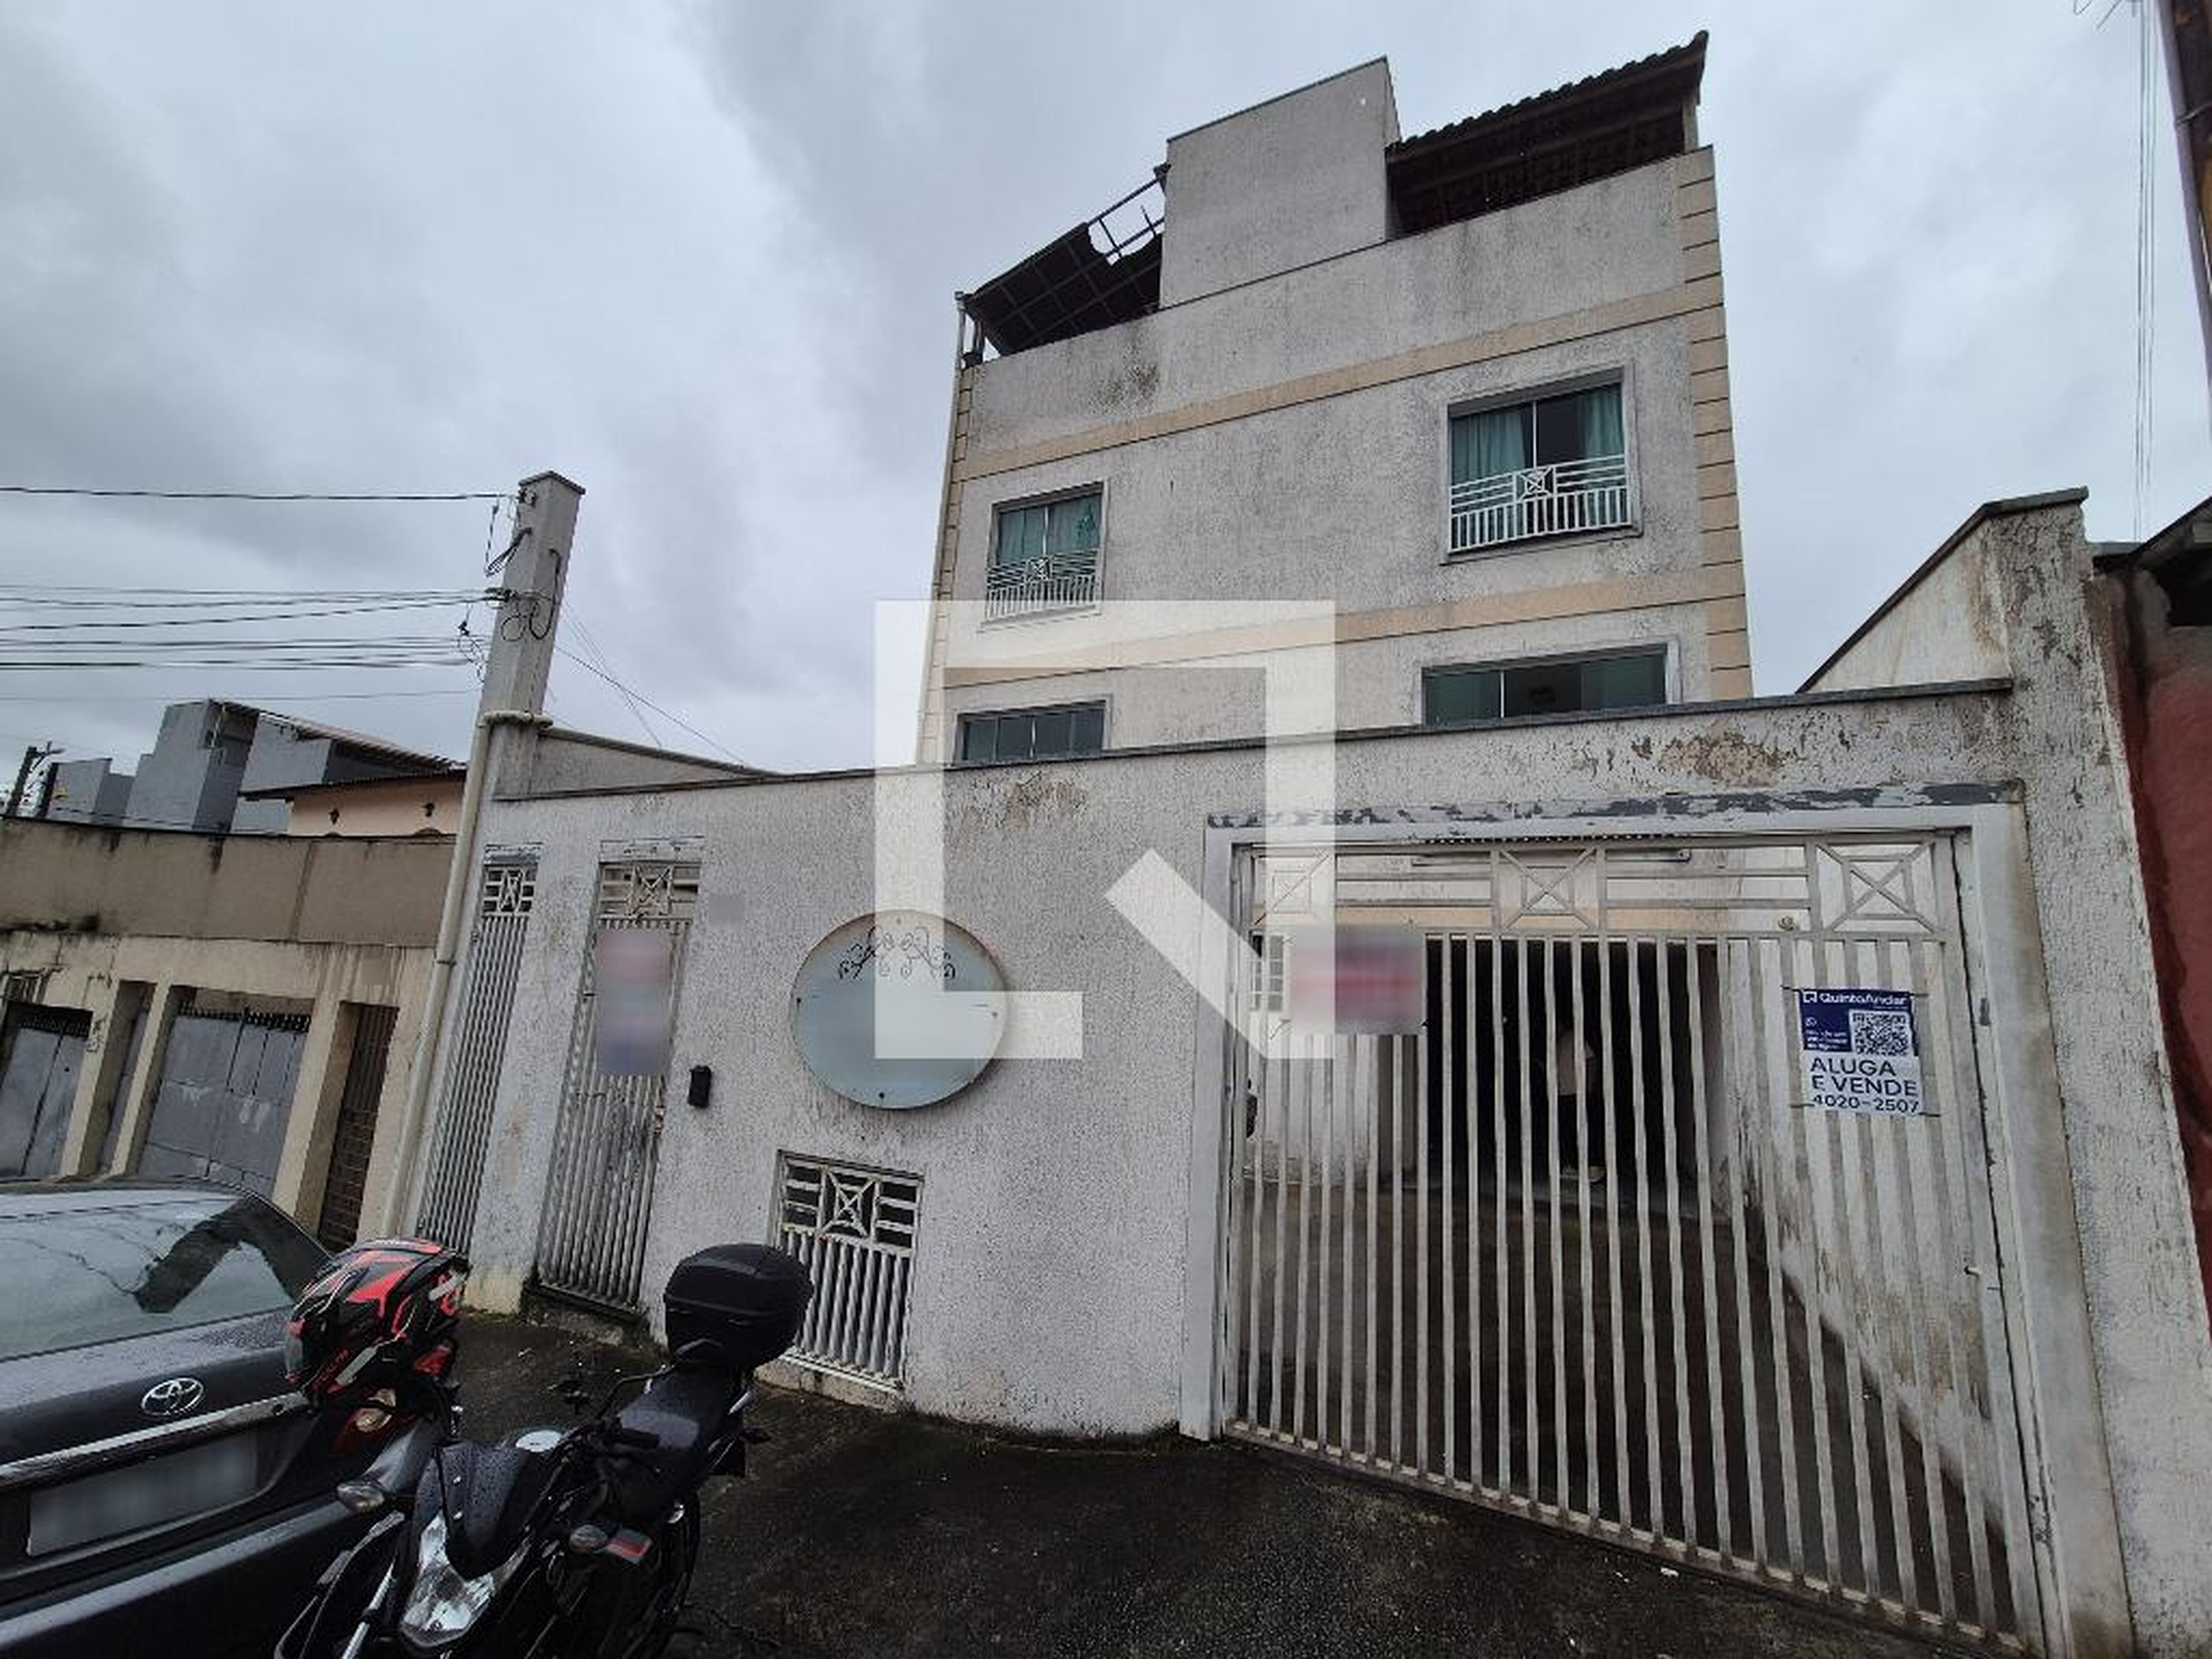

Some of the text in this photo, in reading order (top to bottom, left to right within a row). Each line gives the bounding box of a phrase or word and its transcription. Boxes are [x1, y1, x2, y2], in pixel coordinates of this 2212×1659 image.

[1810, 1058, 1896, 1076] ALUGA
[1812, 1075, 1918, 1096] E VENDE
